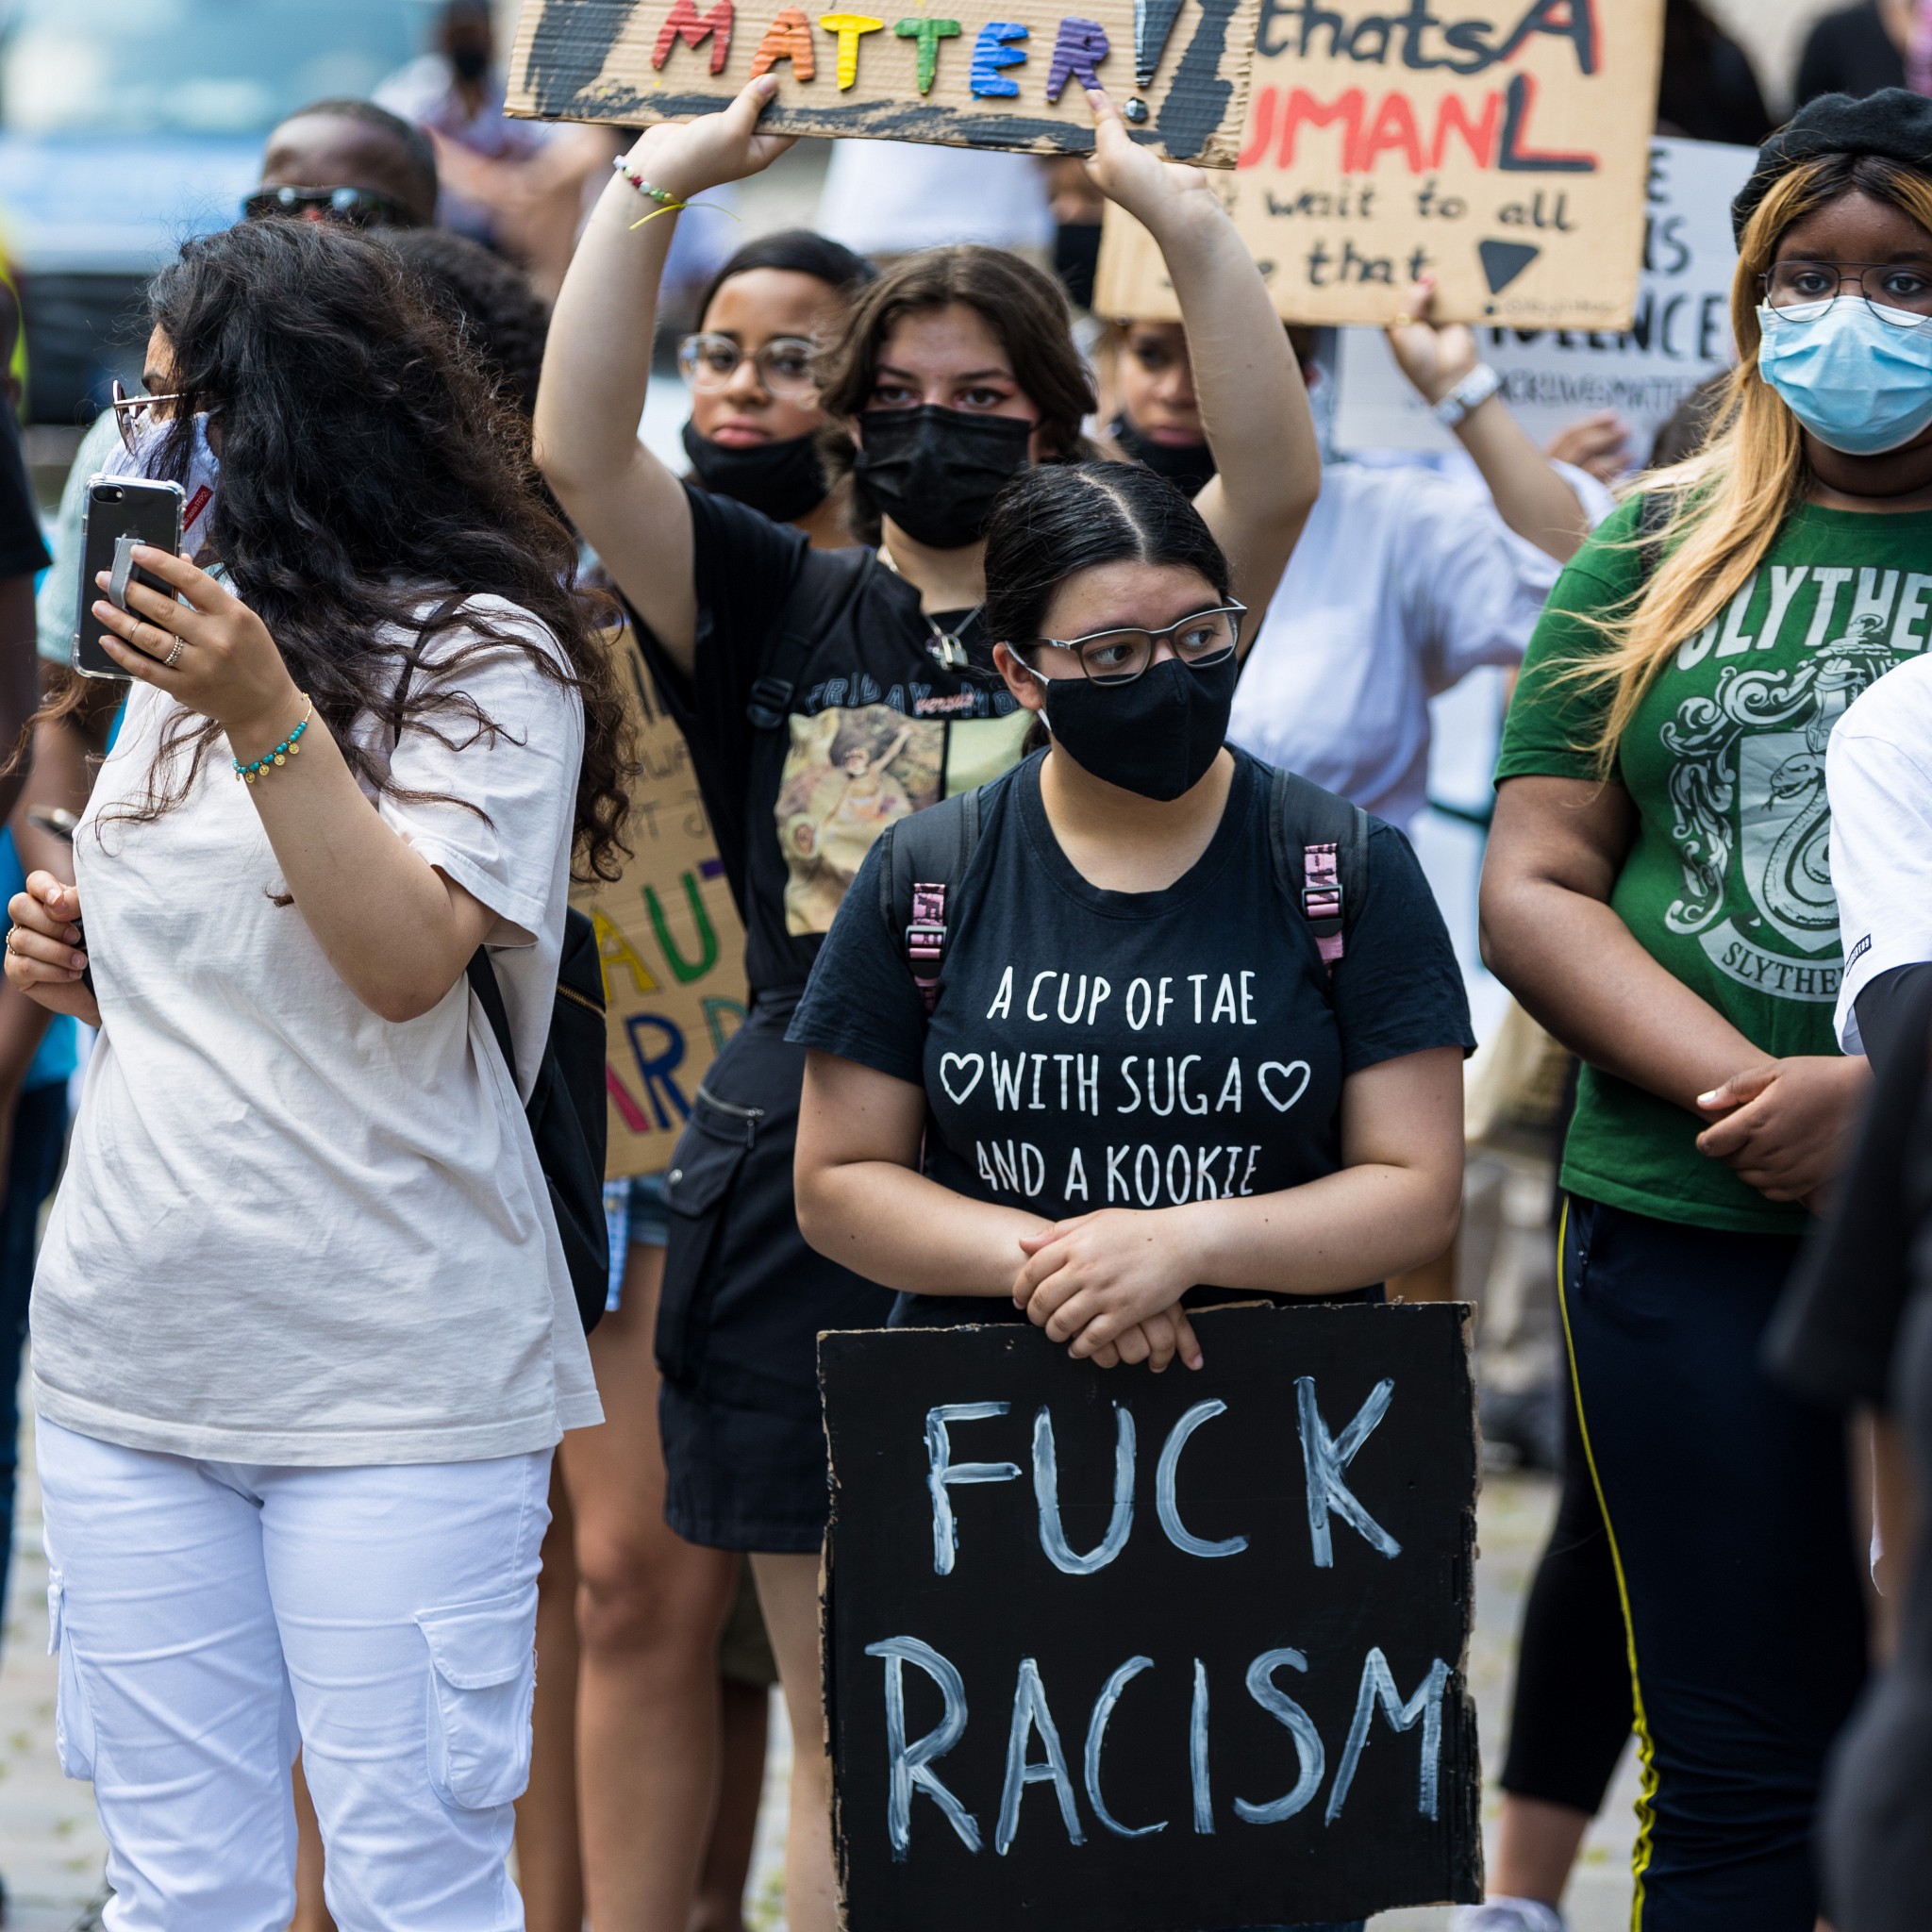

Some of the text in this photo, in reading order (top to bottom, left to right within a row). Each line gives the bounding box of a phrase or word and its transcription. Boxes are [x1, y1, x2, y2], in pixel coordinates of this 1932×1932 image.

[1416, 179, 1468, 220] to
[1498, 191, 1577, 231] all
[1306, 238, 1430, 287] that
[1676, 565, 1932, 672] SLYTHE
[987, 966, 1257, 1031] A CUP OF TAE
[1722, 941, 1846, 995] SLYTHE
[991, 1051, 1242, 1117] WITH SUGA
[975, 1139, 1262, 1208] AND A KOOKIE
[924, 1375, 1403, 1576] FUCK
[864, 1635, 1454, 1864] RACISM
